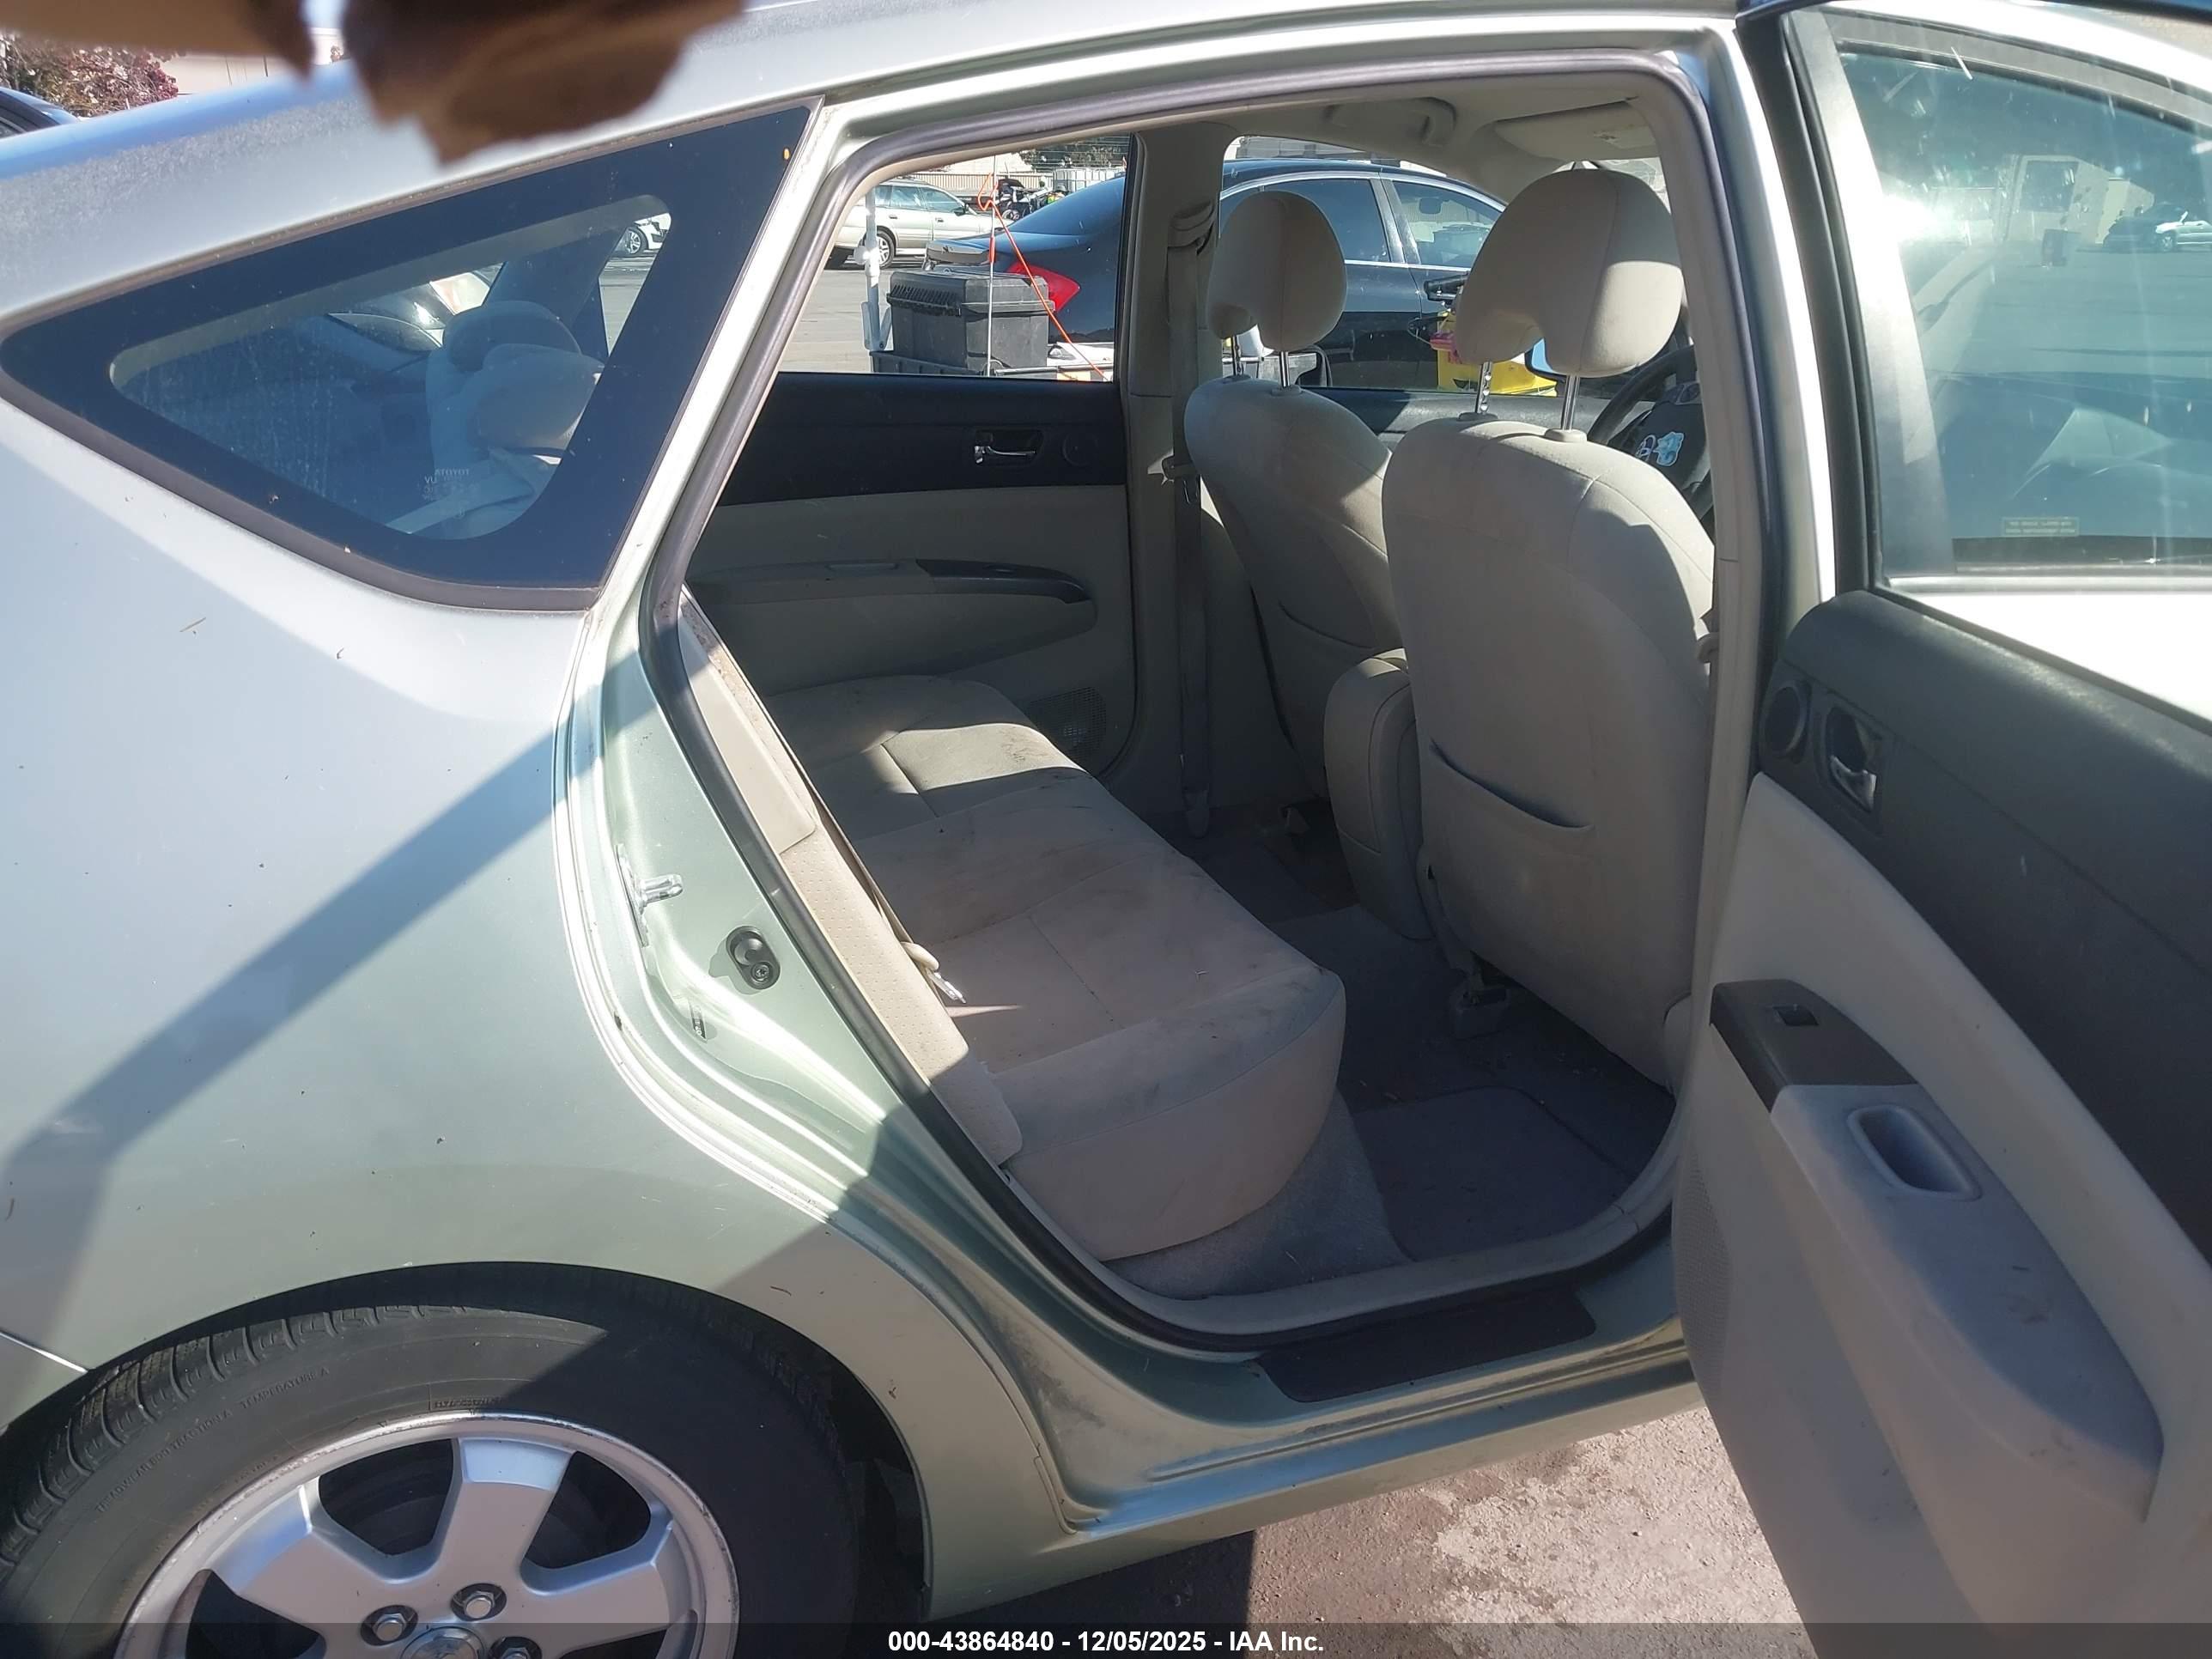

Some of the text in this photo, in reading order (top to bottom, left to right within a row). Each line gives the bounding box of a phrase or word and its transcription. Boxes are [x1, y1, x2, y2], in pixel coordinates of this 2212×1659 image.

[95, 1462, 152, 1512] TREADWEAR
[170, 1413, 223, 1450] TRACTION
[240, 1371, 318, 1408] TEMPERATURE
[320, 1365, 331, 1377] A
